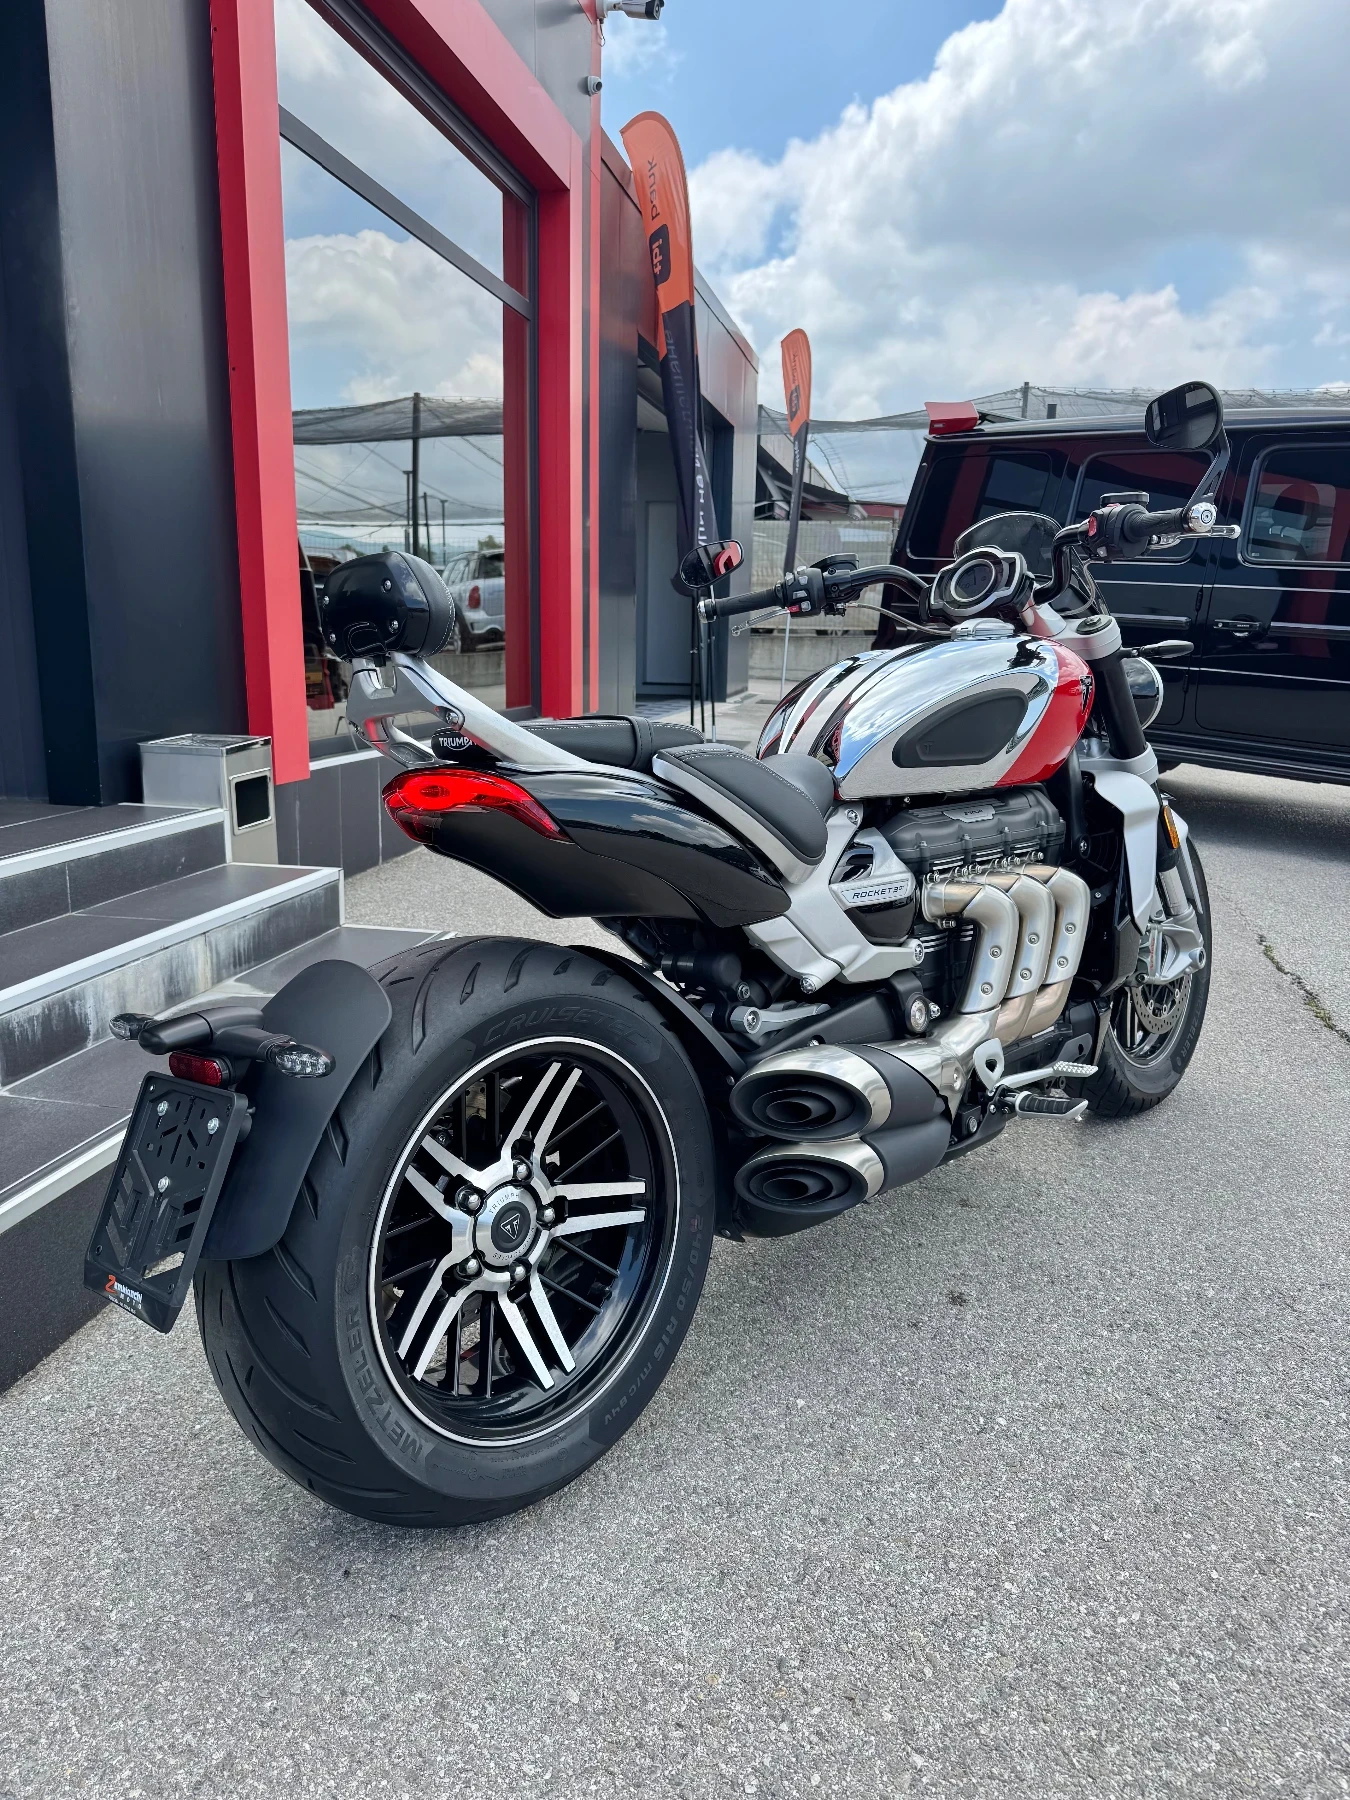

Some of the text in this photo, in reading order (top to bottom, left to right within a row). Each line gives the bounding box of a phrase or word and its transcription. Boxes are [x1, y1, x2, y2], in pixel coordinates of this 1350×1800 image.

[483, 1007, 649, 1047] CRUISETEC
[488, 1192, 519, 1214] TRIUMPH
[676, 1214, 704, 1311] 240/50
[653, 1315, 679, 1362] R16
[345, 1305, 424, 1463] METZELER
